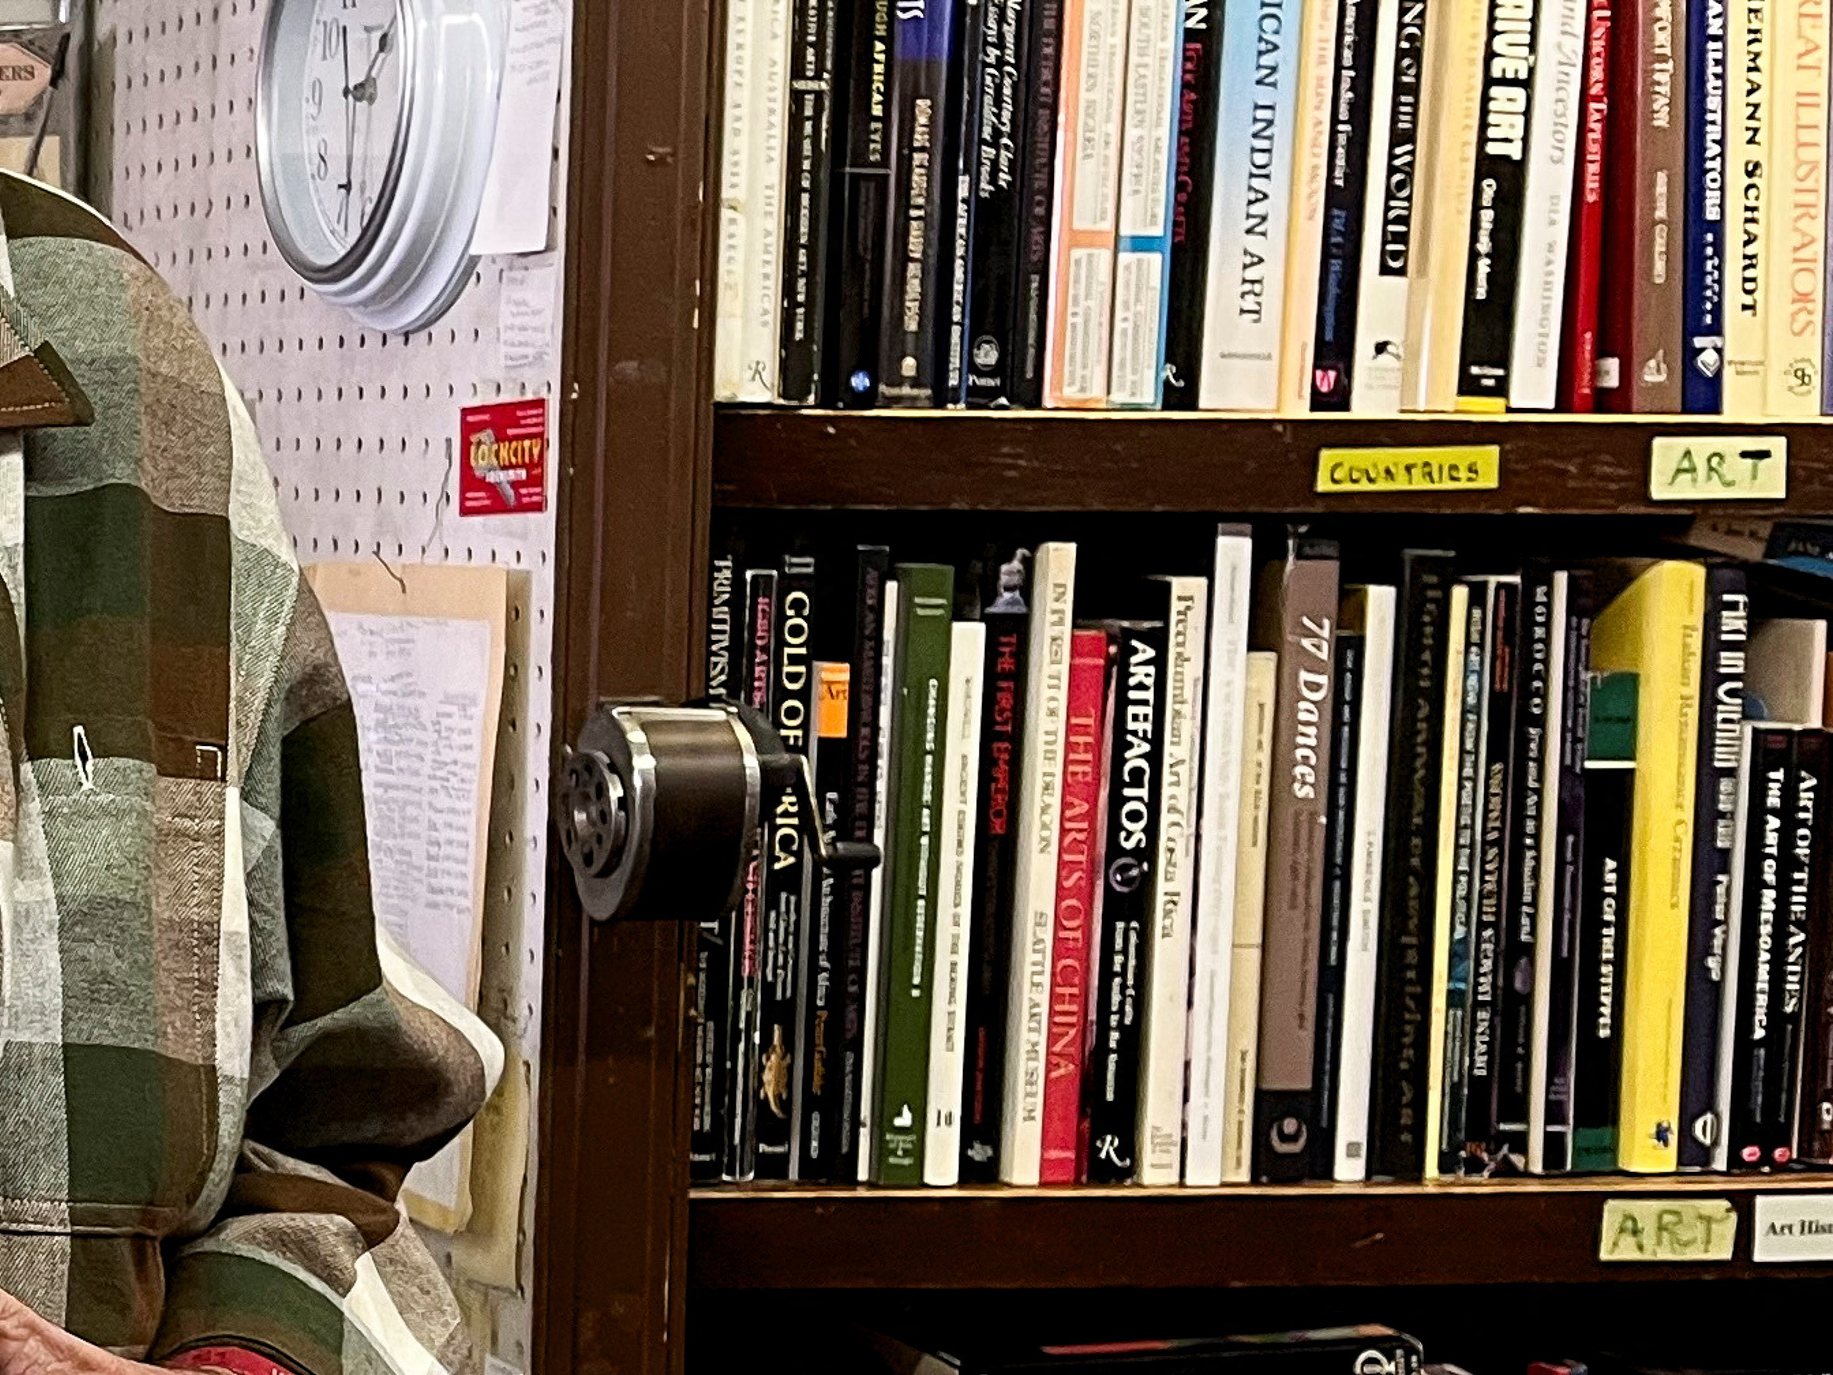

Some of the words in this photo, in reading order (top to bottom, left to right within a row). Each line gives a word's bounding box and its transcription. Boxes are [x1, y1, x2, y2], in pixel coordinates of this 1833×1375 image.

[320, 17, 340, 62] 10
[870, 40, 888, 117] AFRICAN
[1484, 85, 1527, 161] ART
[1548, 41, 1580, 166] Ancestors
[1705, 40, 1723, 221] ILLUSTRATORS
[763, 183, 776, 221] THE
[1245, 101, 1278, 241] INDIAN
[1741, 159, 1764, 318] SCHARDT
[1789, 91, 1821, 338] ILLUSTRATORS
[759, 227, 774, 329] AMERICAS
[1239, 246, 1266, 324] ART
[1329, 456, 1481, 485] COUNTRIES
[1667, 448, 1773, 489] ART
[782, 590, 810, 691] GOLD
[1530, 584, 1549, 715] MOROCCO
[779, 698, 805, 747] OF
[1068, 707, 1097, 787] THE
[1119, 639, 1156, 851] ARTEFACTOS
[1292, 669, 1330, 800] Dances
[1766, 767, 1785, 808] THE
[1796, 769, 1817, 824] ART
[1060, 794, 1093, 881] ARTS
[1764, 813, 1782, 856] ART
[1058, 897, 1087, 948] OF
[1789, 867, 1809, 921] THE
[1752, 889, 1776, 1040] MESOAMERICA
[1782, 925, 1807, 1015] ANDES
[1049, 956, 1082, 1080] CHINA
[1606, 1209, 1735, 1257] ART
[1765, 1219, 1794, 1236] Art
